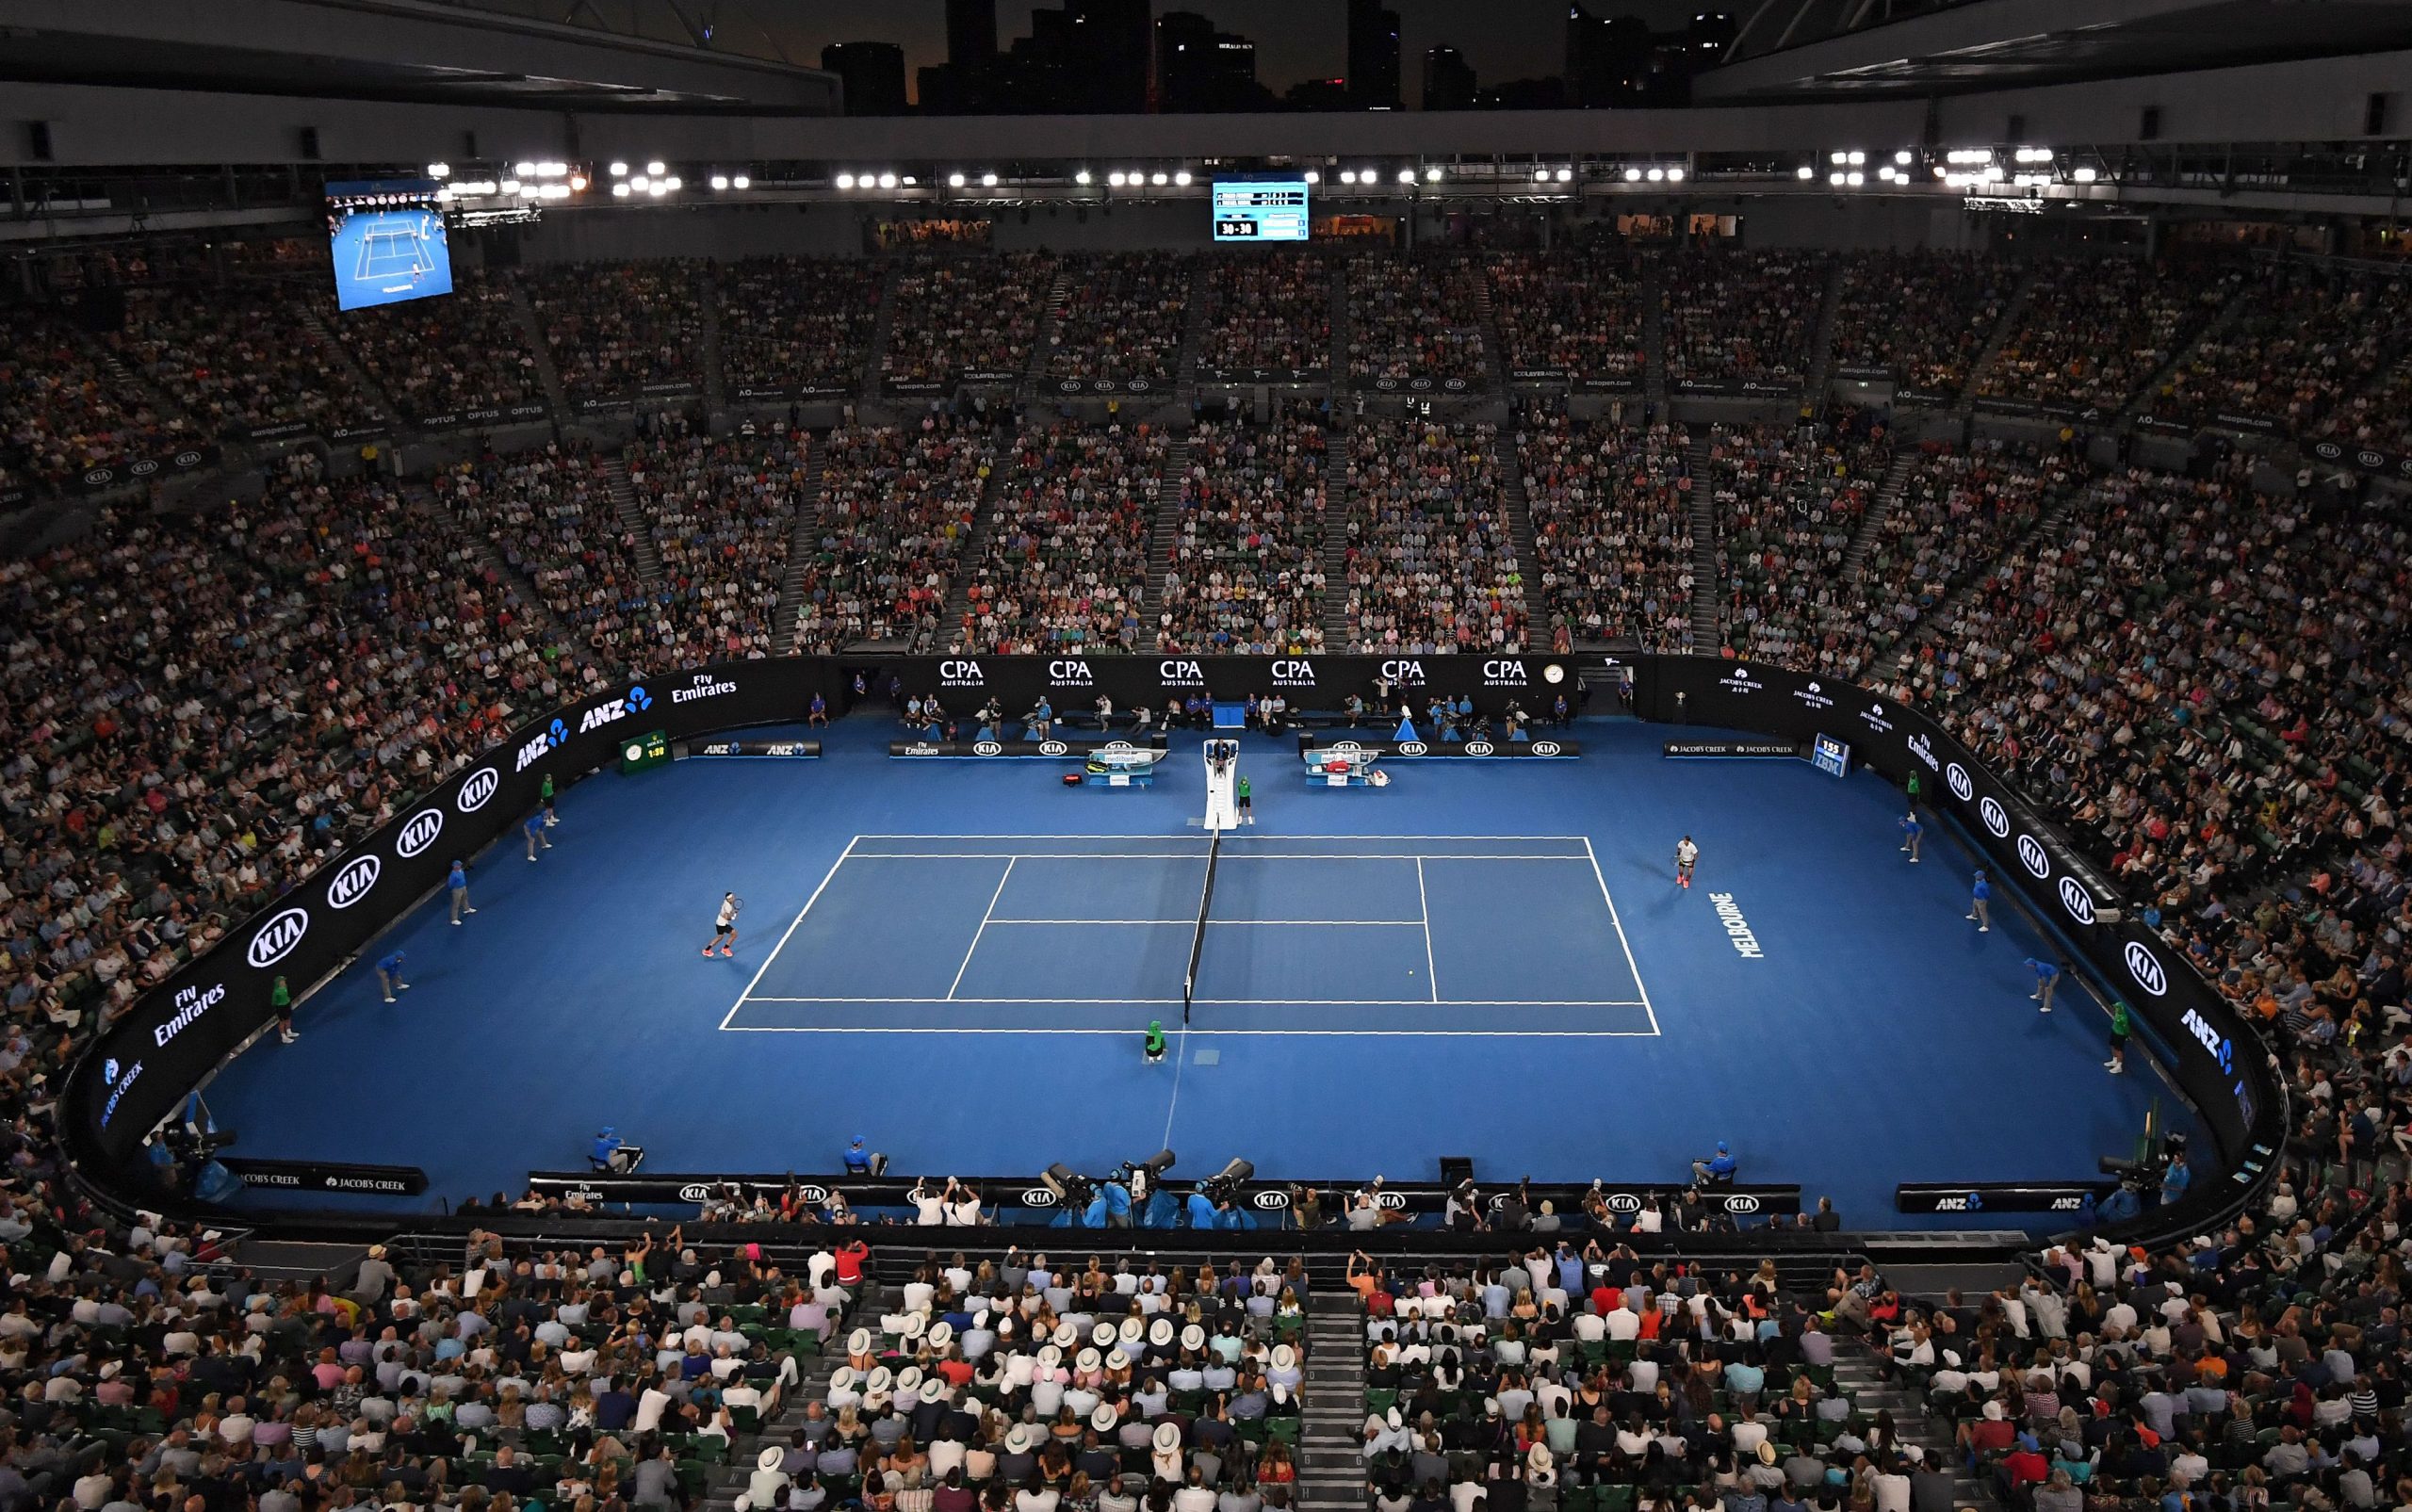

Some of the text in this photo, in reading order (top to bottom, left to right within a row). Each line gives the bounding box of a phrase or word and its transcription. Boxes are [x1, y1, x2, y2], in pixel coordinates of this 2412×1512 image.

[1223, 223, 1233, 235] 30
[1240, 223, 1251, 234] 30
[467, 410, 499, 420] OPTUS
[511, 406, 543, 415] OPTUS
[939, 660, 984, 678] CPA
[1049, 660, 1093, 678] CPA
[1160, 660, 1204, 678] CPA
[1271, 660, 1315, 678] CPA
[1381, 660, 1425, 678] CPA
[1483, 660, 1526, 678] CPA
[693, 675, 712, 685] Fly
[1743, 680, 1763, 689] CREEK
[672, 681, 737, 703] Emirates
[1816, 695, 1833, 706] CREEK
[579, 699, 626, 734] ANZ
[704, 744, 729, 754] ANZ
[1823, 740, 1839, 755] 155
[1920, 733, 1931, 750] Fly
[515, 732, 549, 772] ANZ
[767, 745, 793, 756] ANZ
[904, 746, 938, 756] Emirates
[1908, 735, 1939, 772] Emirates
[1816, 754, 1839, 774] IBM
[1708, 893, 1764, 958] MELBOURNE
[174, 985, 196, 1008] Fly
[154, 983, 225, 1047] Emirates
[2180, 1008, 2220, 1059] ANZ
[118, 1059, 143, 1096] CREEK
[241, 1174, 300, 1184] COB'S CREEK
[338, 1178, 405, 1191] JACOB'S CREEK
[579, 1183, 590, 1192] Fly
[565, 1190, 603, 1199] Emirates
[1935, 1198, 1967, 1211] ANZ
[2051, 1198, 2080, 1210] ANZ
